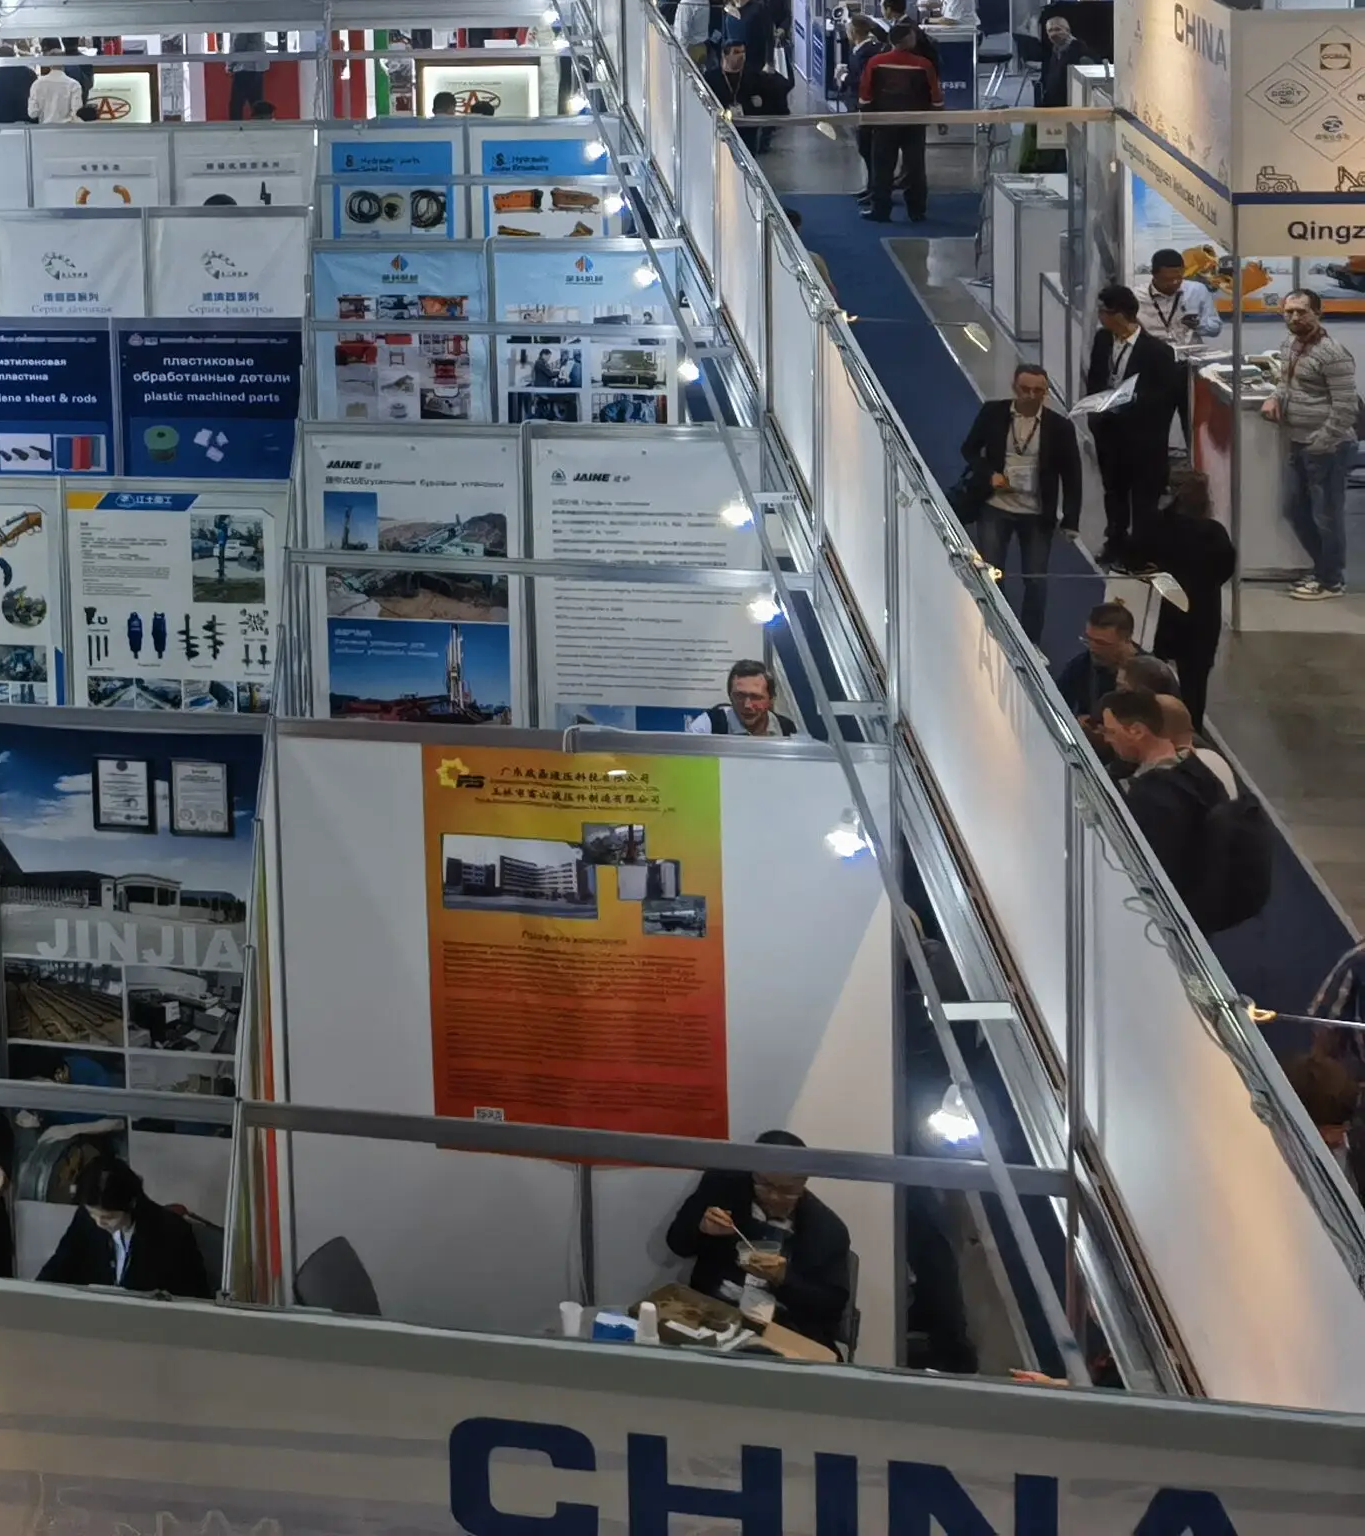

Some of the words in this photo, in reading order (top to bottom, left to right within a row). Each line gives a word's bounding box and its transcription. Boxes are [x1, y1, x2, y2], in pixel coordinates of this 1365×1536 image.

[1174, 3, 1228, 71] CHINA
[162, 356, 255, 367] пластиковые
[133, 371, 236, 384] обработанные
[239, 372, 291, 384] детали
[25, 393, 57, 404] sheet
[59, 393, 69, 404] &
[72, 393, 98, 404] rods
[144, 391, 183, 404] plastic
[186, 391, 246, 403] machined
[248, 392, 281, 404] parts
[326, 460, 363, 470] JAINE
[573, 472, 611, 482] JAINE
[36, 917, 246, 971] JINJIA
